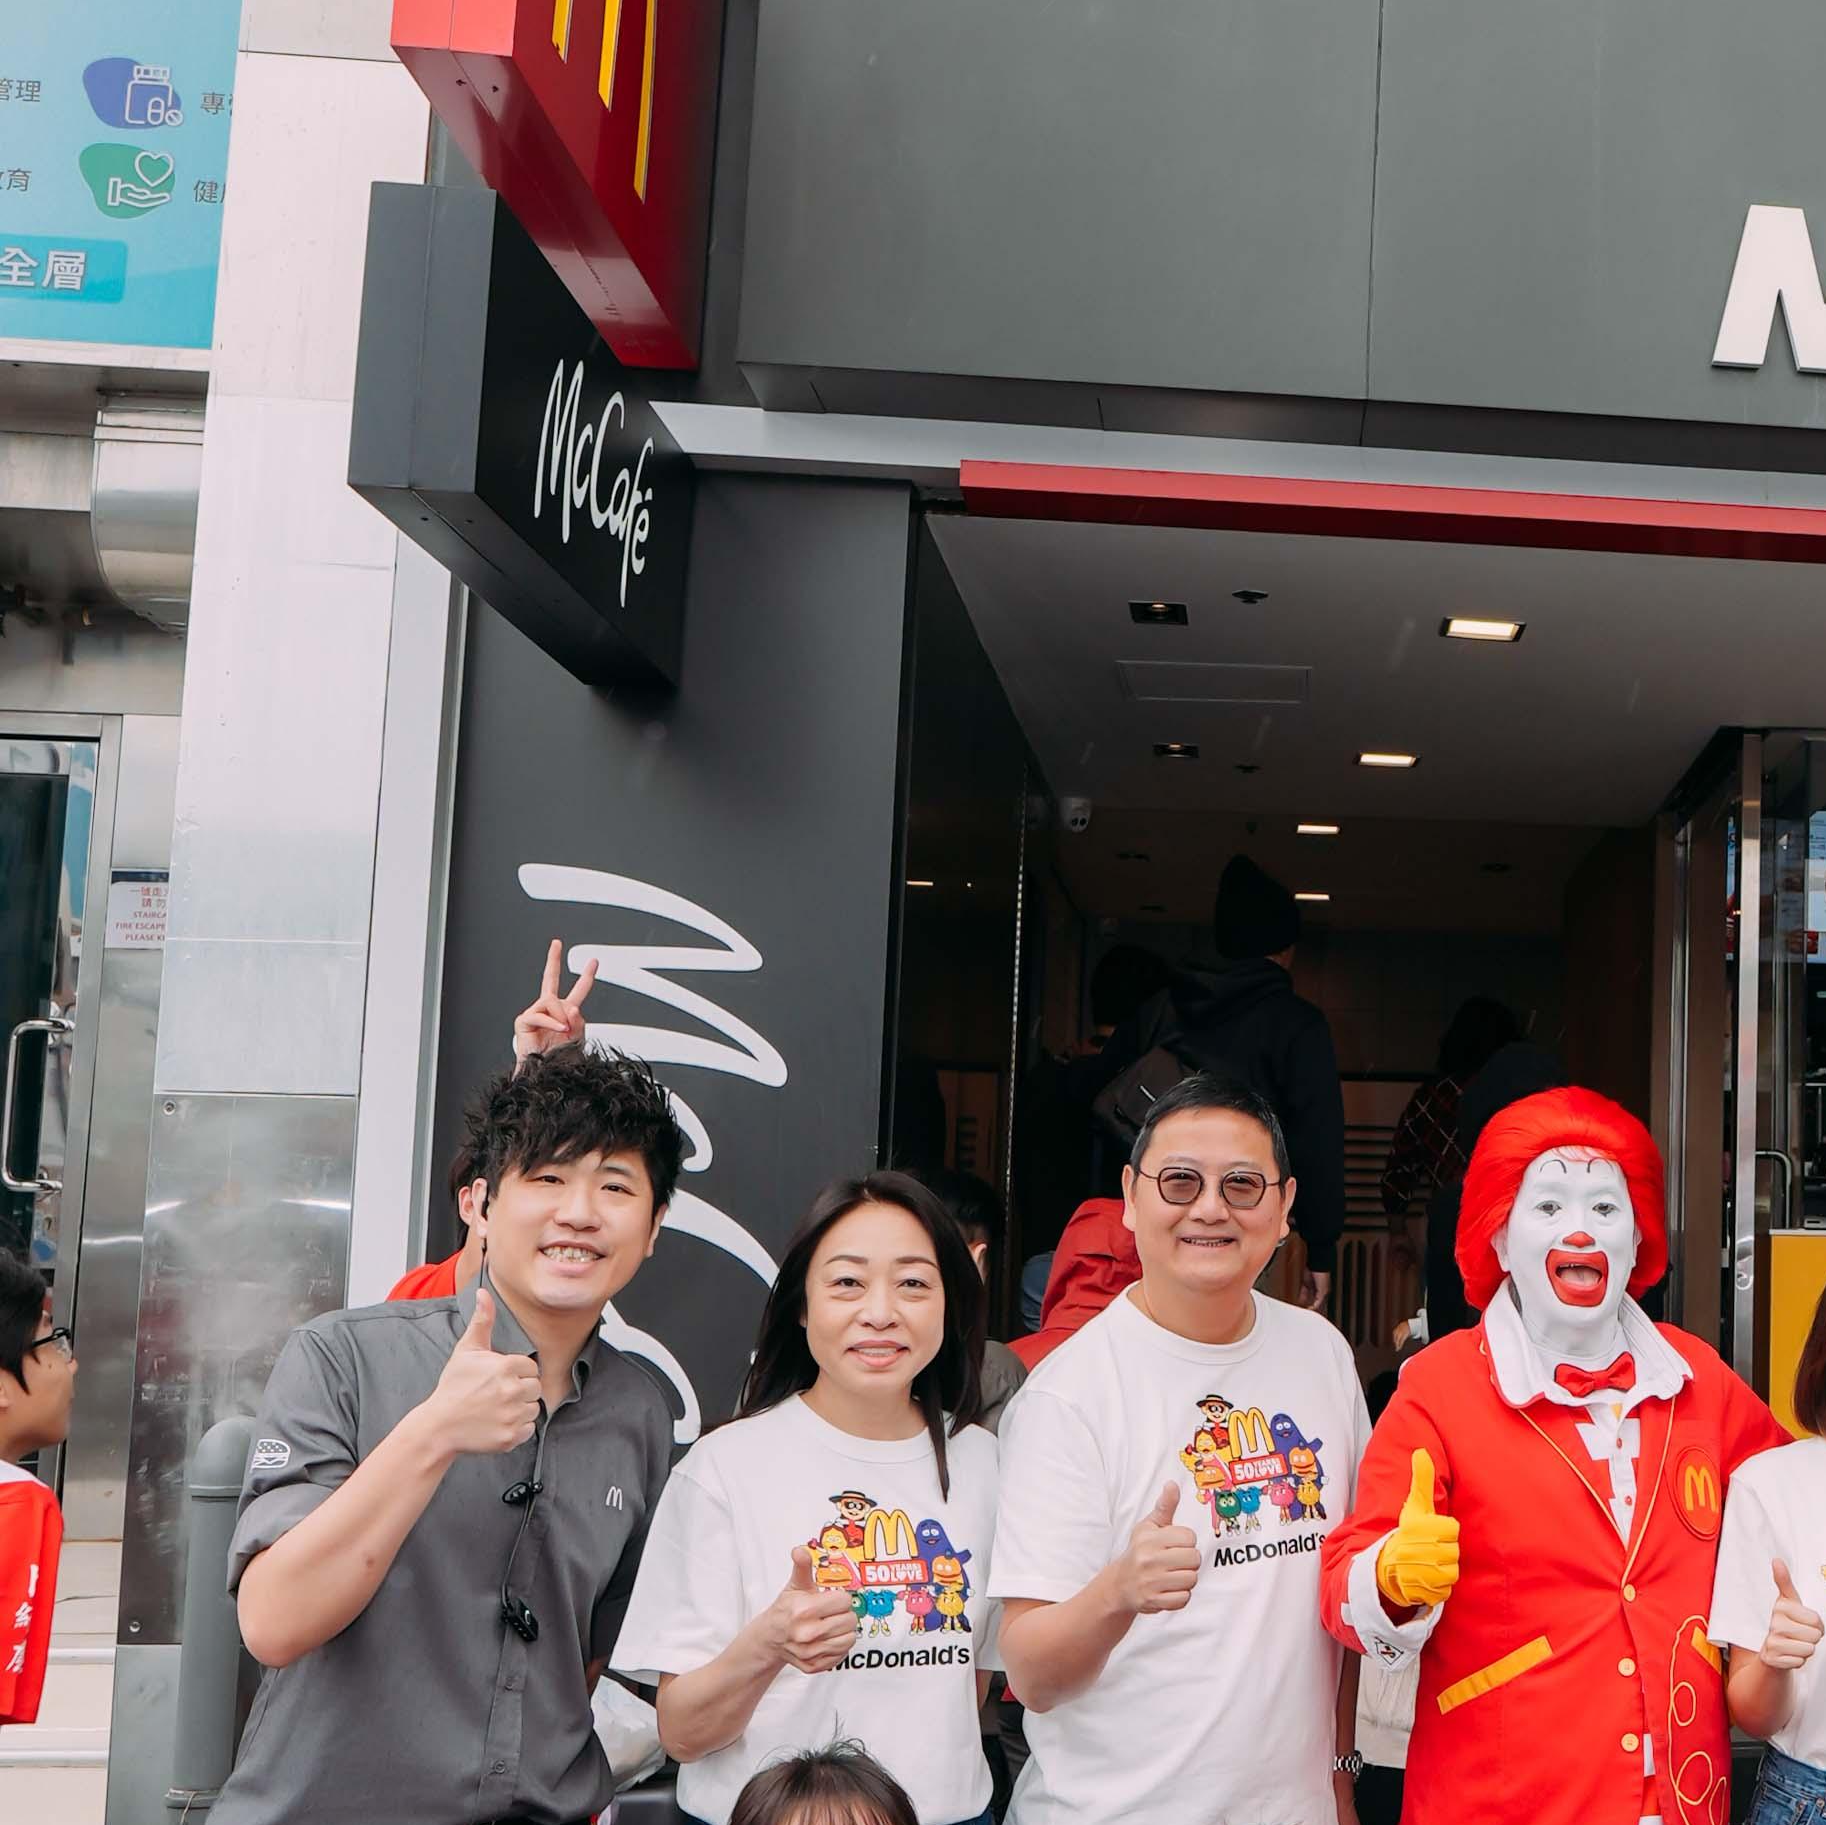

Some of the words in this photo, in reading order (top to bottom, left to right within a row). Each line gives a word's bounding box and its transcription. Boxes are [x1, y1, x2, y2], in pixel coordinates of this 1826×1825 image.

[533, 358, 654, 609] McCafé
[115, 922, 133, 930] FIRE
[1214, 1532, 1327, 1567] McDonald's
[864, 1564, 890, 1583] 50
